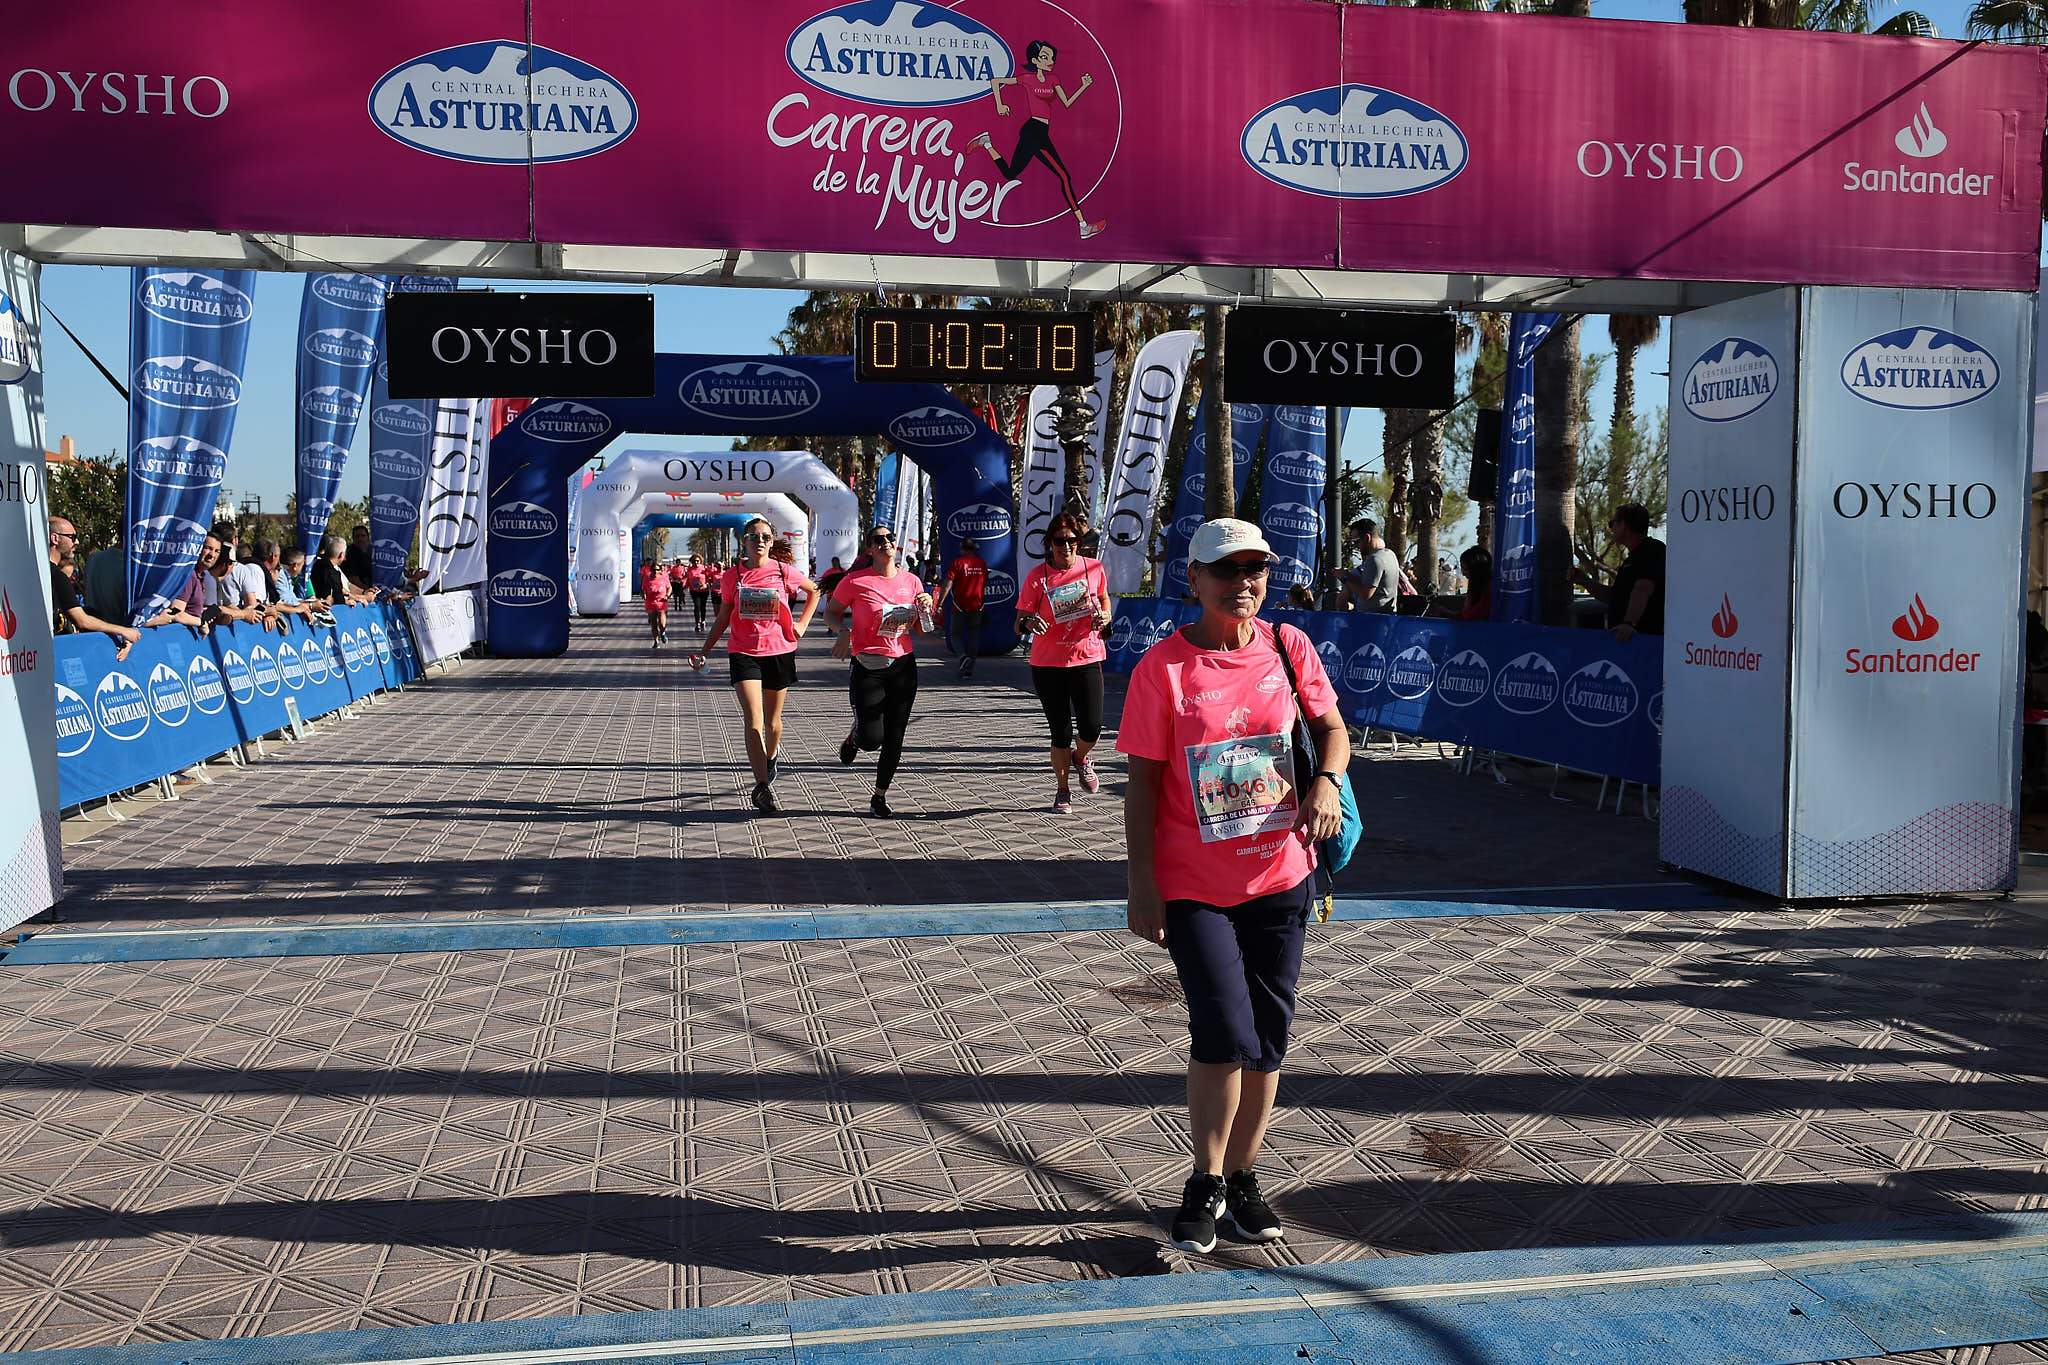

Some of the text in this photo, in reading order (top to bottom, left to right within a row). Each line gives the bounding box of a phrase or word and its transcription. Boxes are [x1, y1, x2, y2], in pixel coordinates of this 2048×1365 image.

[840, 31, 990, 50] CENTRAL LECHERA
[804, 32, 997, 82] ASTURIANA
[8, 68, 229, 118] OYSHO
[431, 81, 609, 99] CENTRAL LECHERA
[390, 82, 617, 134] ASTURIANA
[767, 93, 953, 156] Carrera
[1294, 122, 1444, 139] CENTRAL LECHERA
[1260, 122, 1451, 171] ASTURIANA
[812, 154, 880, 195] de la
[1576, 140, 1744, 183] OYSHO
[1843, 161, 1995, 197] Santander
[875, 152, 1022, 244] Mujer
[144, 284, 244, 319] ASTURIANA
[431, 326, 618, 366] OYSHO
[873, 320, 1076, 371] 01:02:18
[1263, 339, 1423, 377] OYSHO
[1702, 361, 1768, 379] CENTRAL LECHERA
[1852, 356, 1988, 389] ASTURIANA
[1877, 355, 1983, 365] CENTRAL LECHERA
[140, 368, 236, 401] ASTURIANA
[689, 379, 810, 406] ASTURIANA
[711, 378, 806, 387] CENTRAL LECHERA
[1688, 372, 1771, 405] ASTURIANA
[526, 412, 604, 434] ASTURIANA
[896, 423, 971, 438] ASTURIANA
[135, 450, 223, 479] ASTURIANA
[1107, 364, 1176, 547] OYSHO
[663, 459, 775, 481] OYSHO
[596, 483, 631, 492] OYSHO
[1833, 482, 1997, 519] OYSHO
[1681, 484, 1775, 523] OYSHO
[492, 515, 553, 530] ASTURIANA
[581, 528, 614, 537] OYSHO
[822, 529, 853, 537] OYSHO
[951, 518, 1010, 531] ASTURIANA
[492, 581, 552, 597] ASTURIANA
[581, 573, 613, 581] OYSHO
[1685, 641, 1763, 672] Santander
[1845, 647, 1981, 673] Santander
[1390, 663, 1431, 688] ASTURIANA
[1440, 669, 1485, 693] ASTURIANA
[1497, 673, 1553, 701] ASTURIANA
[1179, 690, 1221, 708] OYSHO
[1567, 680, 1628, 714] ASTURIANA
[100, 700, 148, 727] ASTURIANA
[1203, 814, 1229, 824] CARRERA
[1239, 809, 1248, 817] LA
[1248, 806, 1267, 816] MUJER
[1210, 822, 1245, 835] OYSHO
